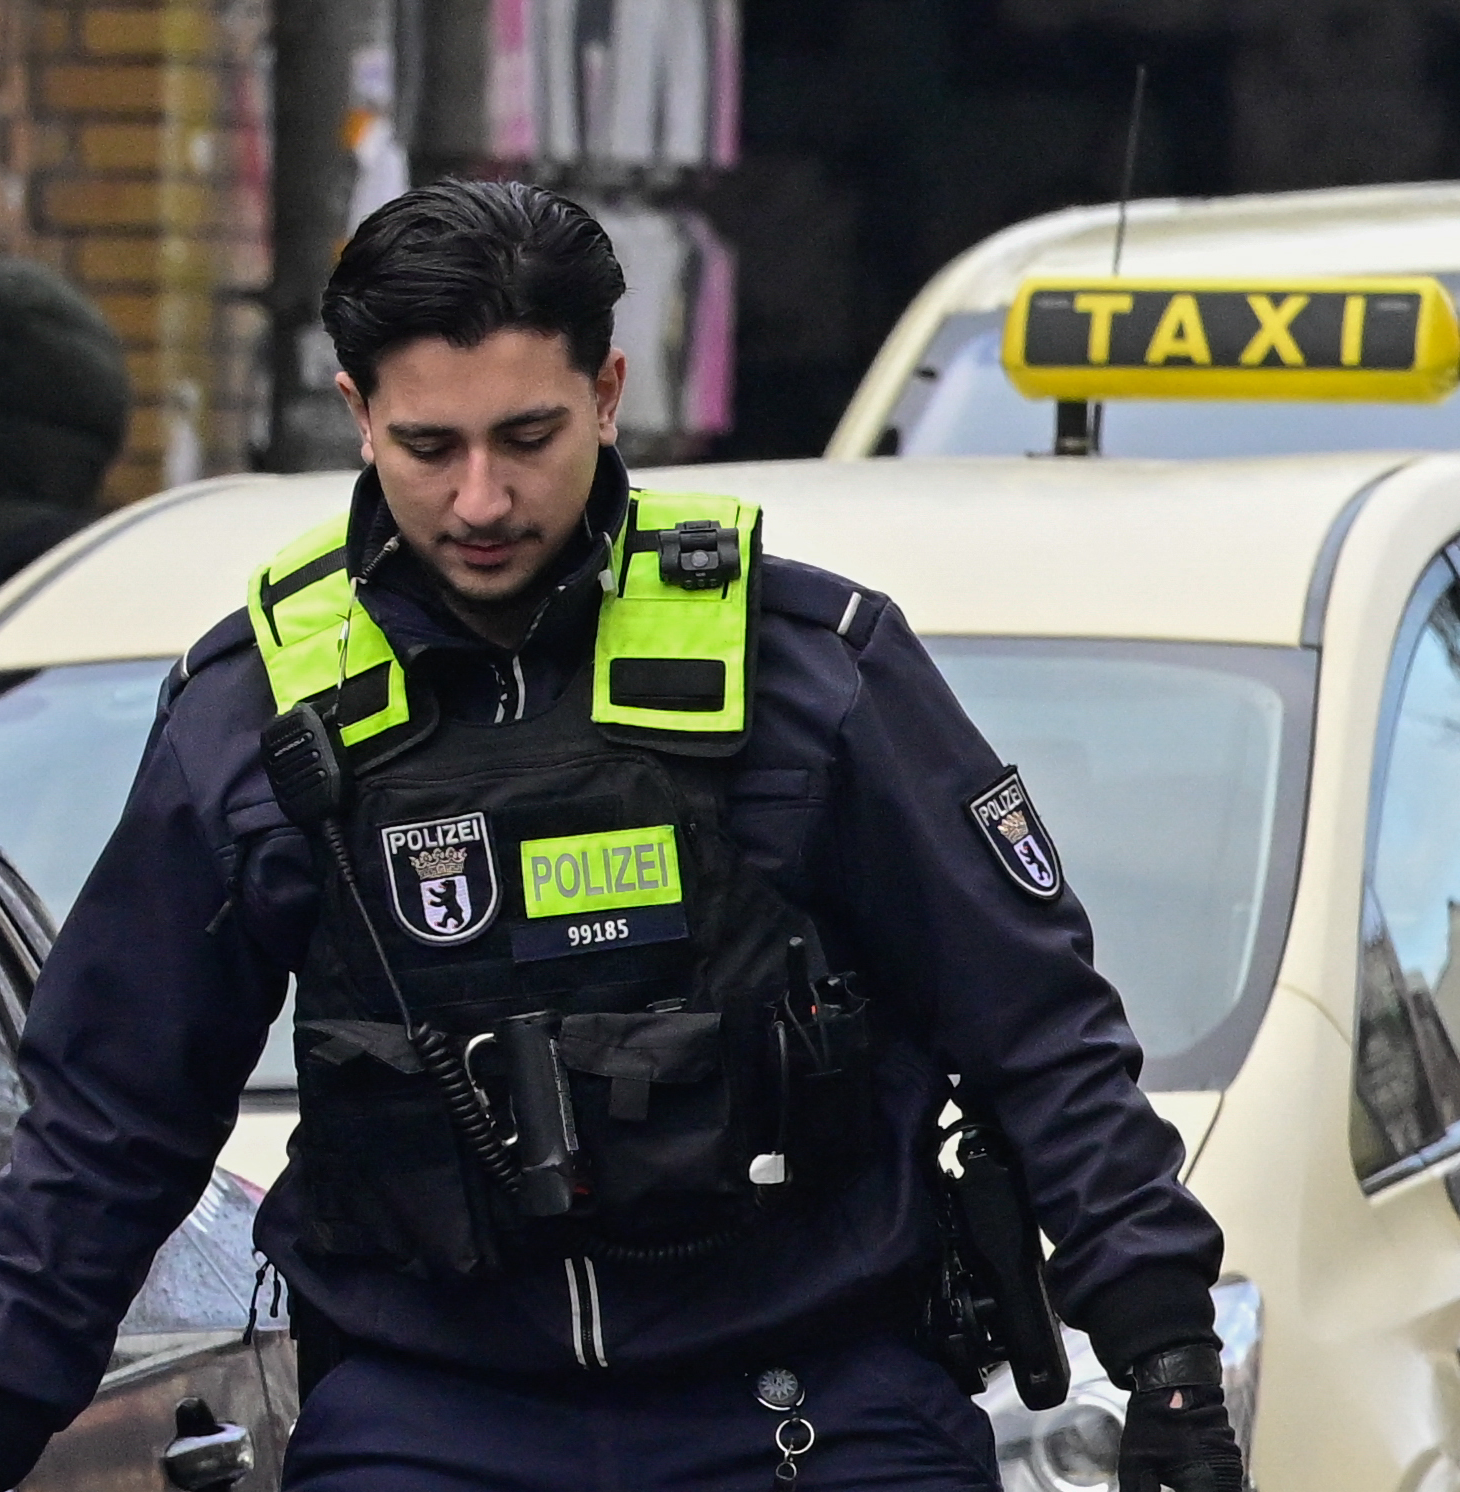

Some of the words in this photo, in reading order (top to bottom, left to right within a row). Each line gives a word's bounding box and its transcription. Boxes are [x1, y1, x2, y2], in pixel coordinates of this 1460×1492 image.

[1073, 293, 1367, 367] TAXI
[389, 818, 480, 855] POLIZEI
[531, 842, 669, 902] POLIZEI
[567, 918, 630, 947] 99185
